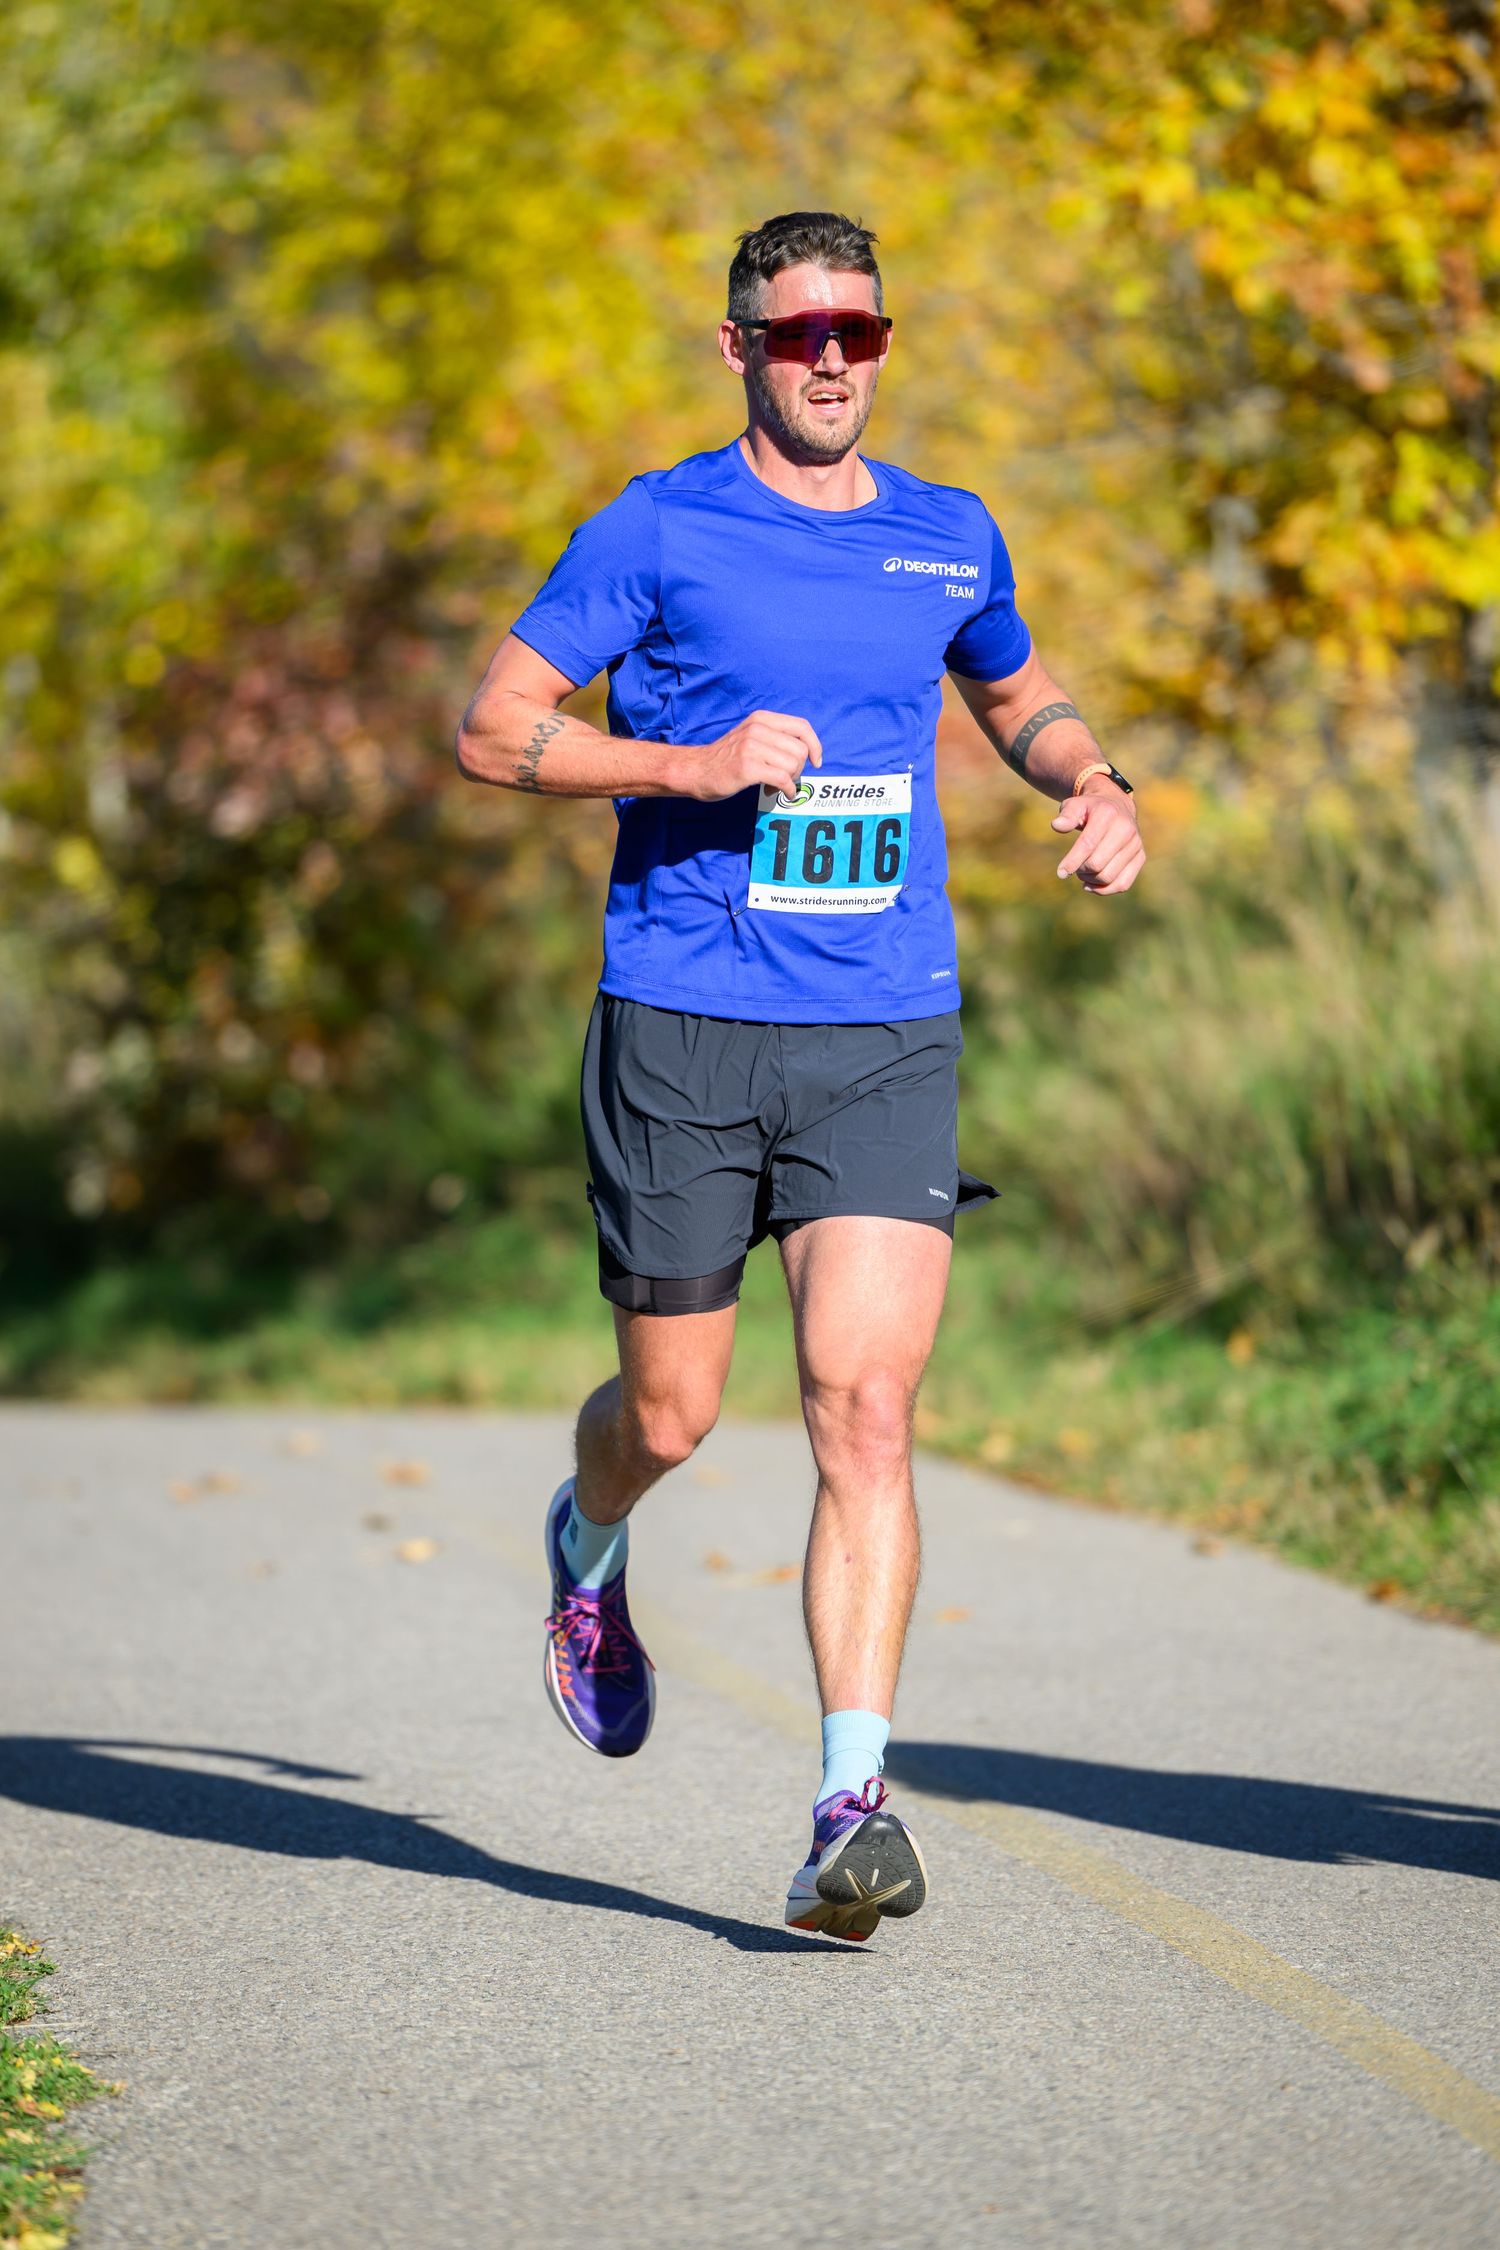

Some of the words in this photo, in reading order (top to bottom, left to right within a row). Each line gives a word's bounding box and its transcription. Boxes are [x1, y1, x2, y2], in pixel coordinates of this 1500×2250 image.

[903, 560, 979, 578] DECATHLON
[945, 584, 975, 600] TEAM
[819, 784, 885, 799] Strides
[813, 799, 861, 808] RUNNING
[863, 797, 893, 807] STORE
[768, 818, 902, 884] 1616
[770, 895, 887, 907] www.stridesrunning.com
